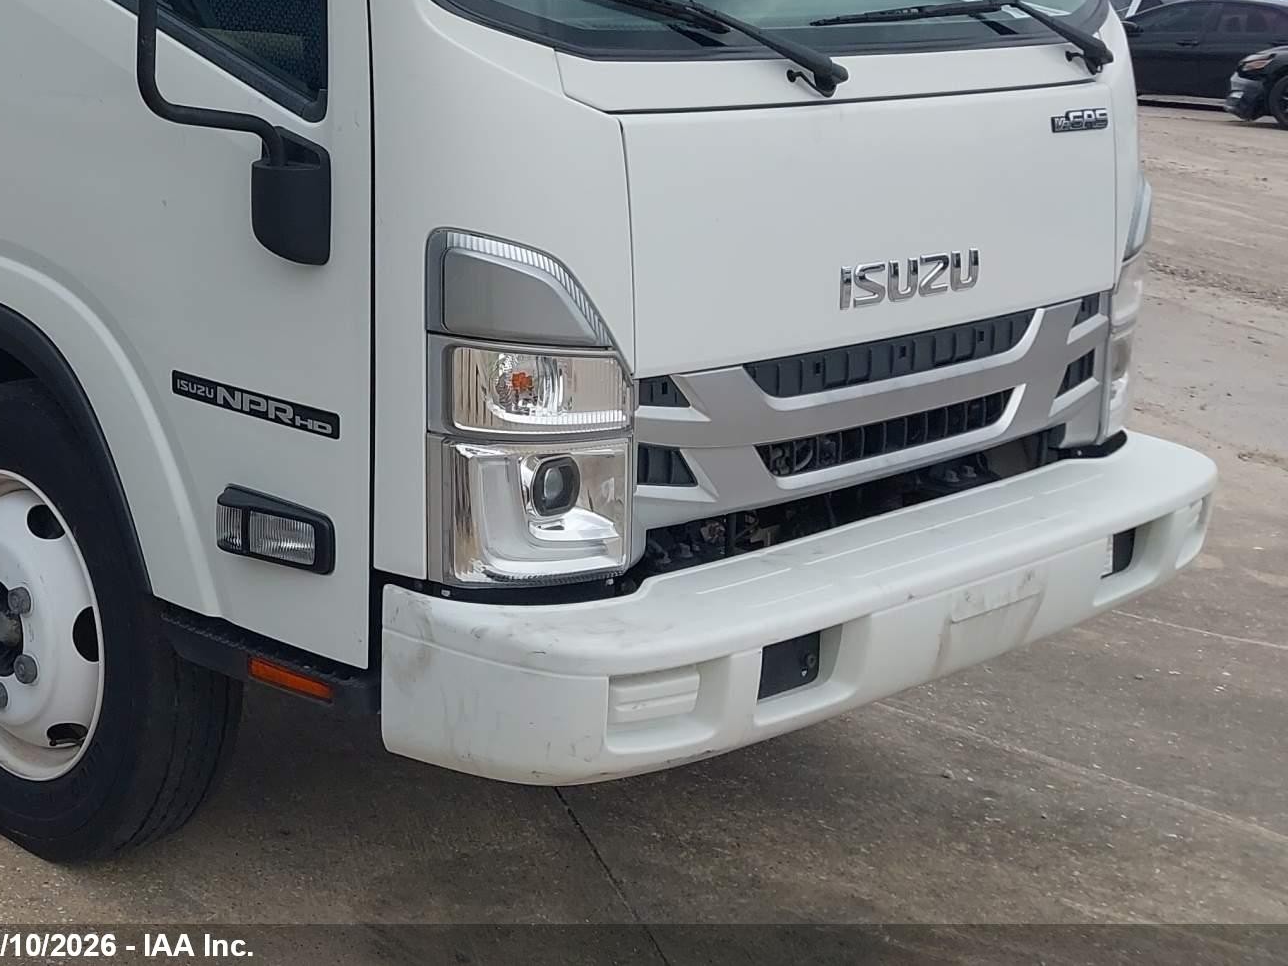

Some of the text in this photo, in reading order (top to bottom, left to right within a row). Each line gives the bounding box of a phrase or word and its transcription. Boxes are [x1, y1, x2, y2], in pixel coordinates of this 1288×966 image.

[839, 247, 980, 311] ISUZU
[176, 378, 333, 435] ISUZU NPR HD
